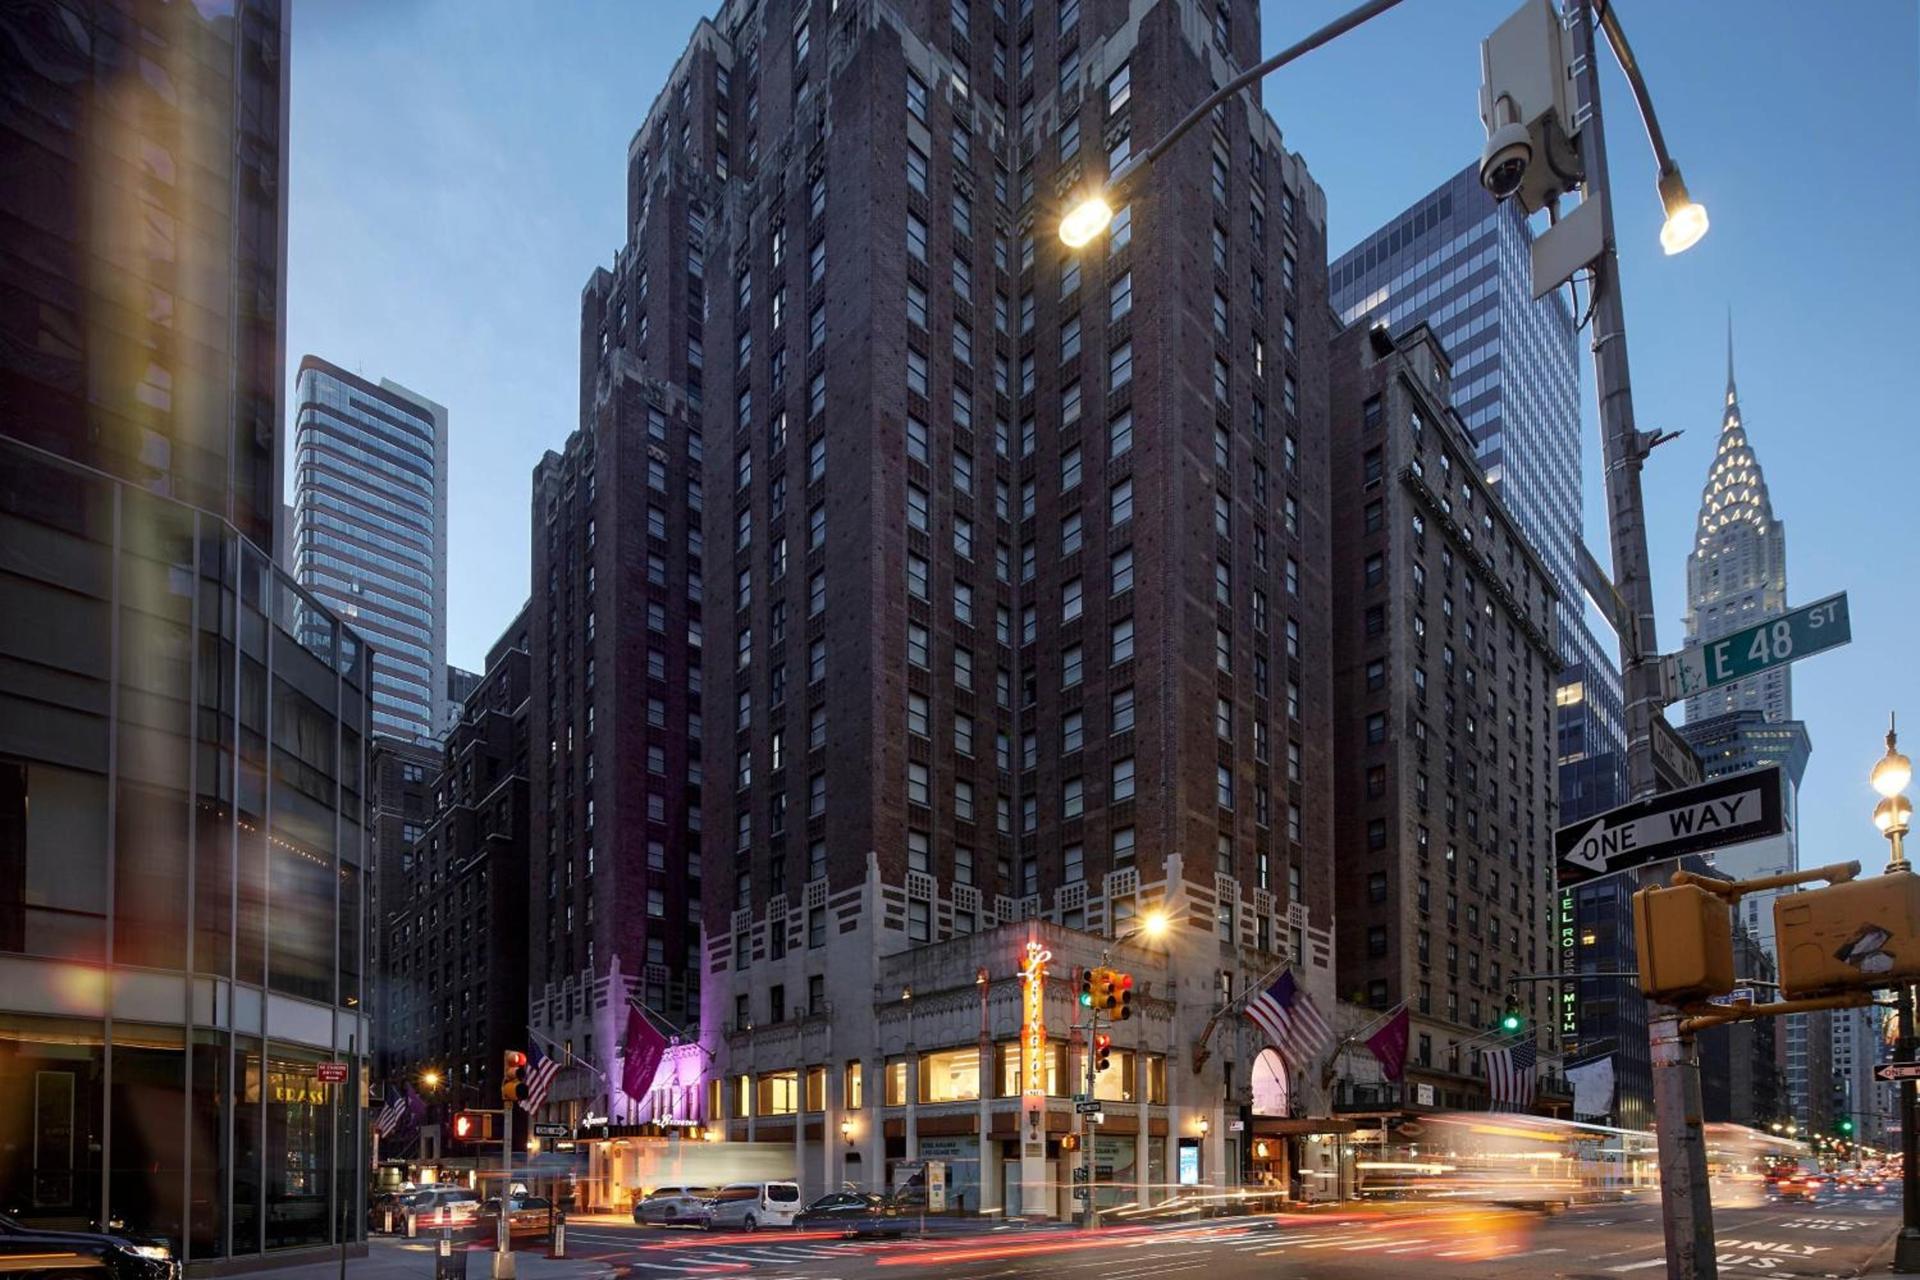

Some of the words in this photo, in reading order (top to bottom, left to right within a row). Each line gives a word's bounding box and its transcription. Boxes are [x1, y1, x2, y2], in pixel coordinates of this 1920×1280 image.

[1714, 640, 1734, 680] E
[1747, 621, 1793, 664] 48
[1808, 604, 1839, 630] ST
[1582, 824, 1637, 862] ONE
[1669, 795, 1744, 837] WAY
[1562, 927, 1575, 975] ROGER
[1563, 982, 1576, 1031] SMITH
[1884, 1067, 1905, 1077] ONE
[1714, 1239, 1834, 1255] ONLY
[1716, 1253, 1785, 1268] US
